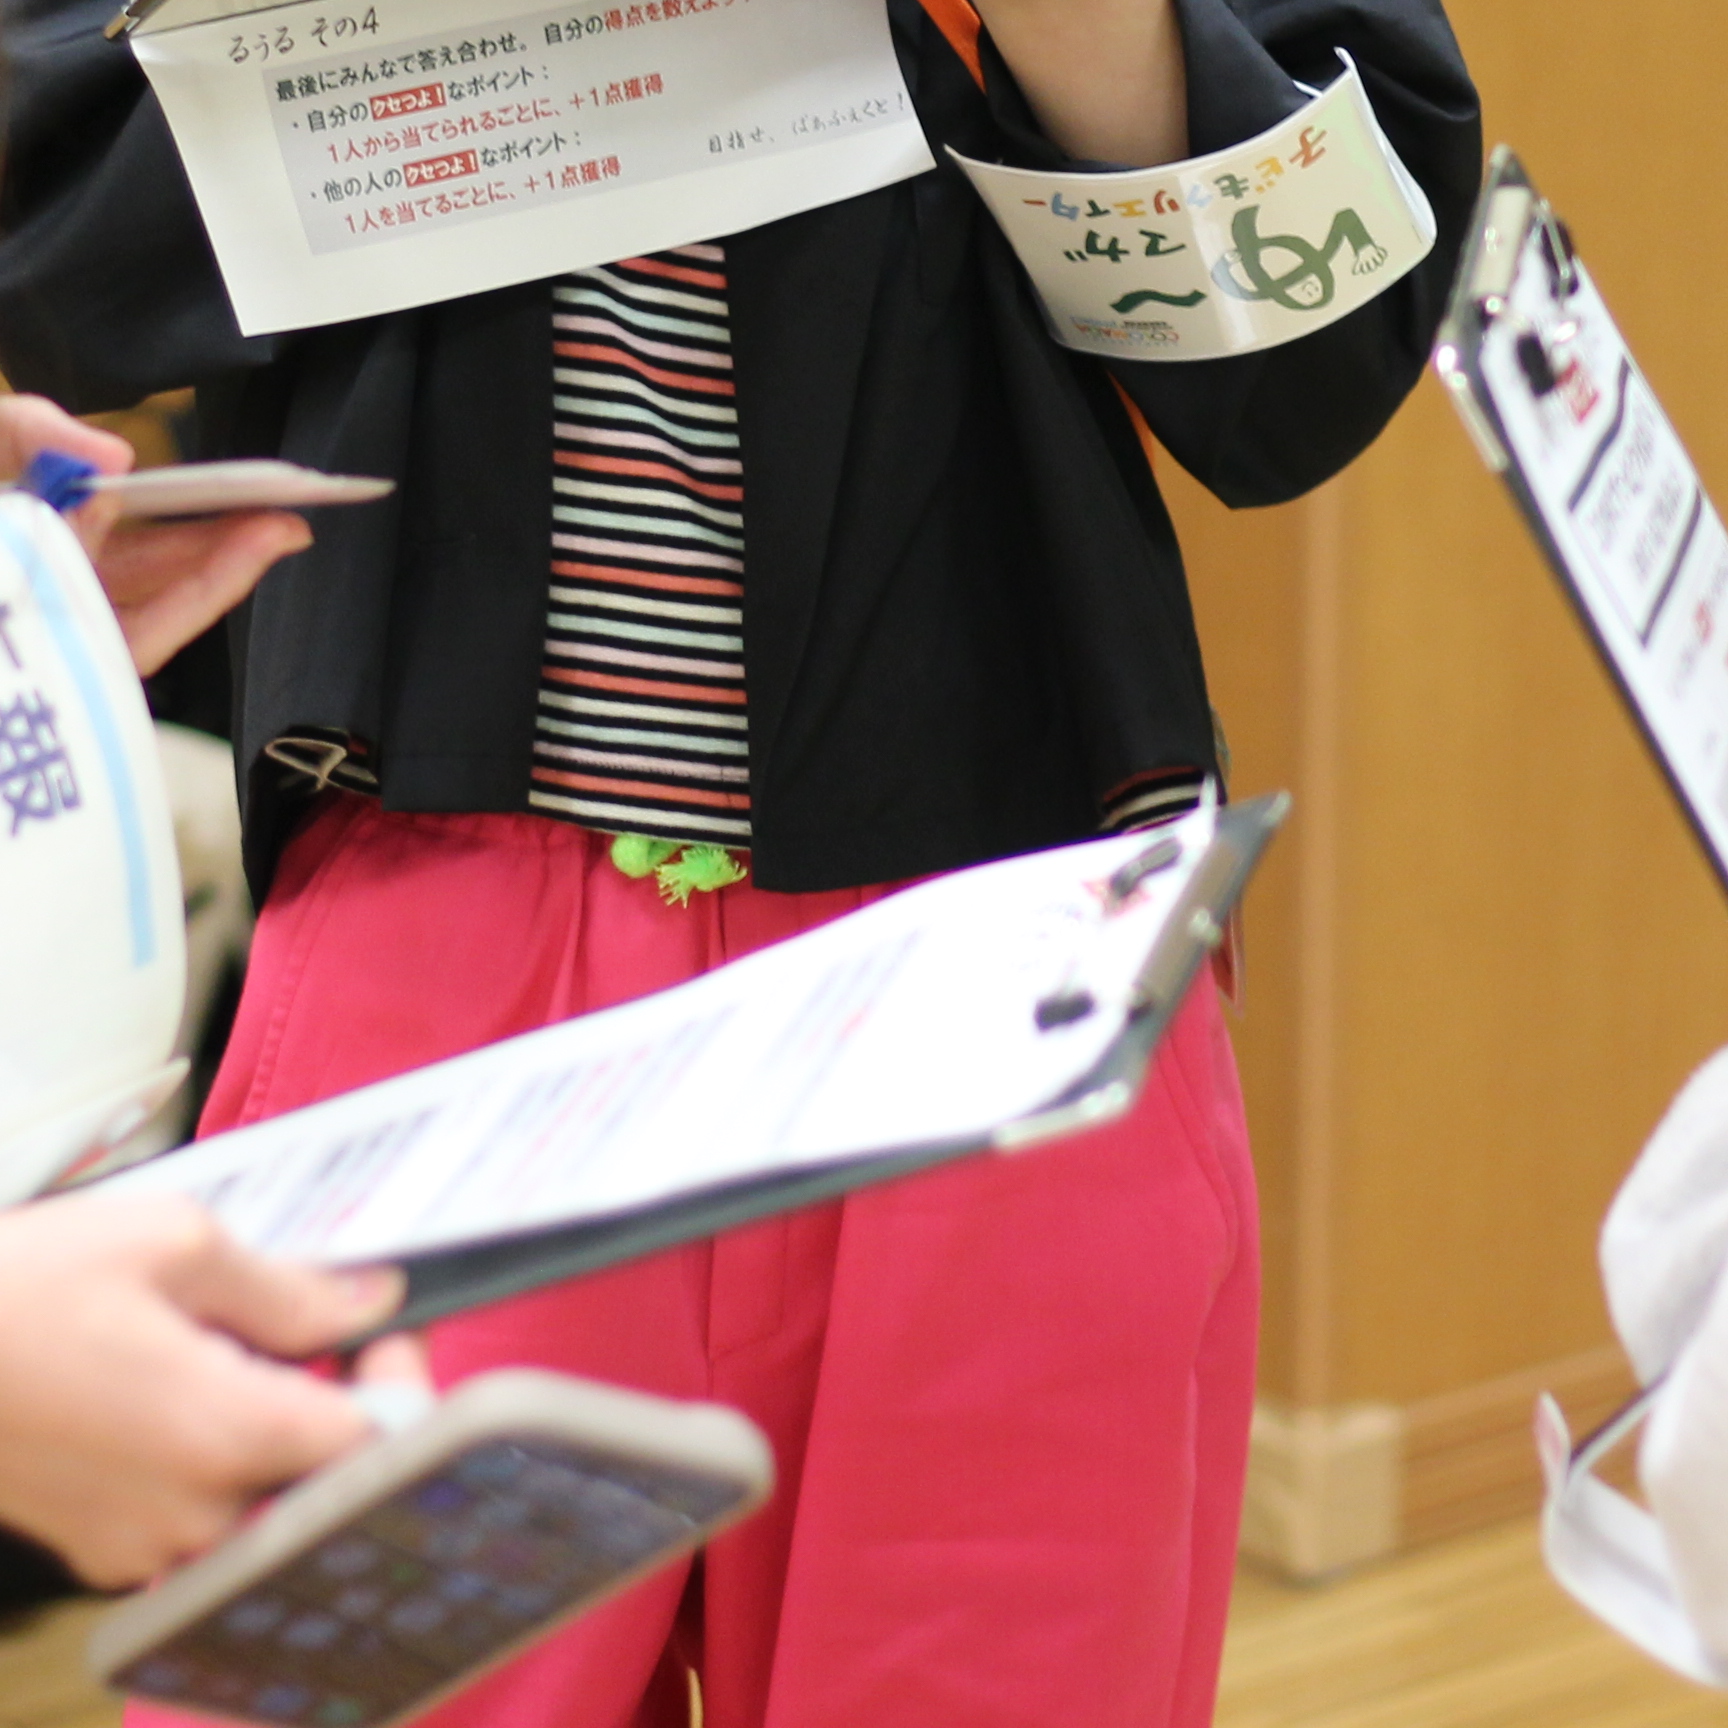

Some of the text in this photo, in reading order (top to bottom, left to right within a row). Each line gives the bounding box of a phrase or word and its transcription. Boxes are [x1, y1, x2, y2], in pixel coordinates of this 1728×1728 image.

[229, 6, 379, 63] るうる その4
